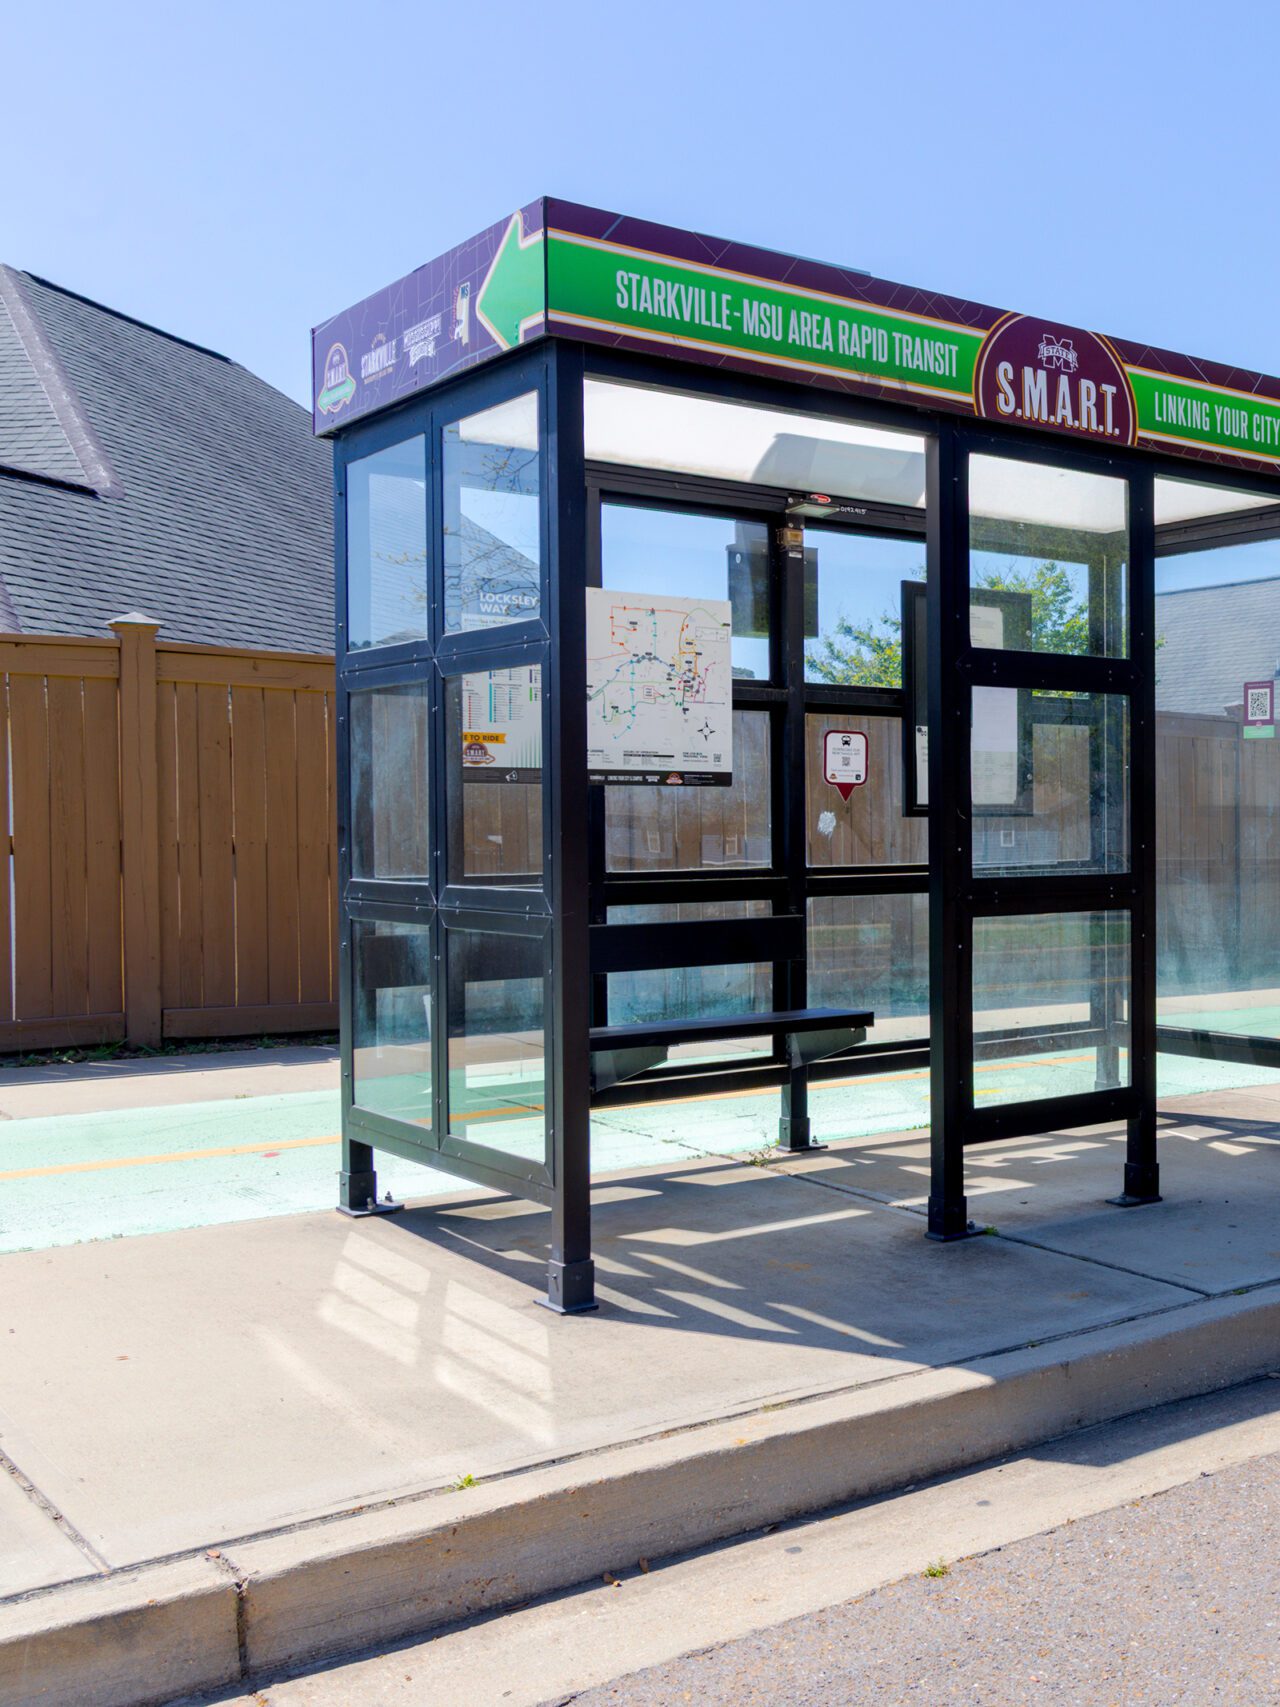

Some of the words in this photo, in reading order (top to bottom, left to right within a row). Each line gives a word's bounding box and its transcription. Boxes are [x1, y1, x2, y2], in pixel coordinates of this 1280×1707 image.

[615, 269, 783, 342] STARKVILLE-MSU
[788, 310, 833, 353] AREA
[838, 320, 888, 364] RAPID
[892, 332, 959, 378] TRANSIT
[361, 338, 397, 379] STARKVILLE
[1045, 346, 1071, 360] STATE
[996, 360, 1120, 436] S.M.A.R.T.
[1154, 391, 1210, 432] LINKING
[1214, 403, 1249, 440] YOUR
[1252, 412, 1280, 449] CITY
[479, 591, 539, 606] LOCKSLEY
[479, 603, 508, 614] WAY
